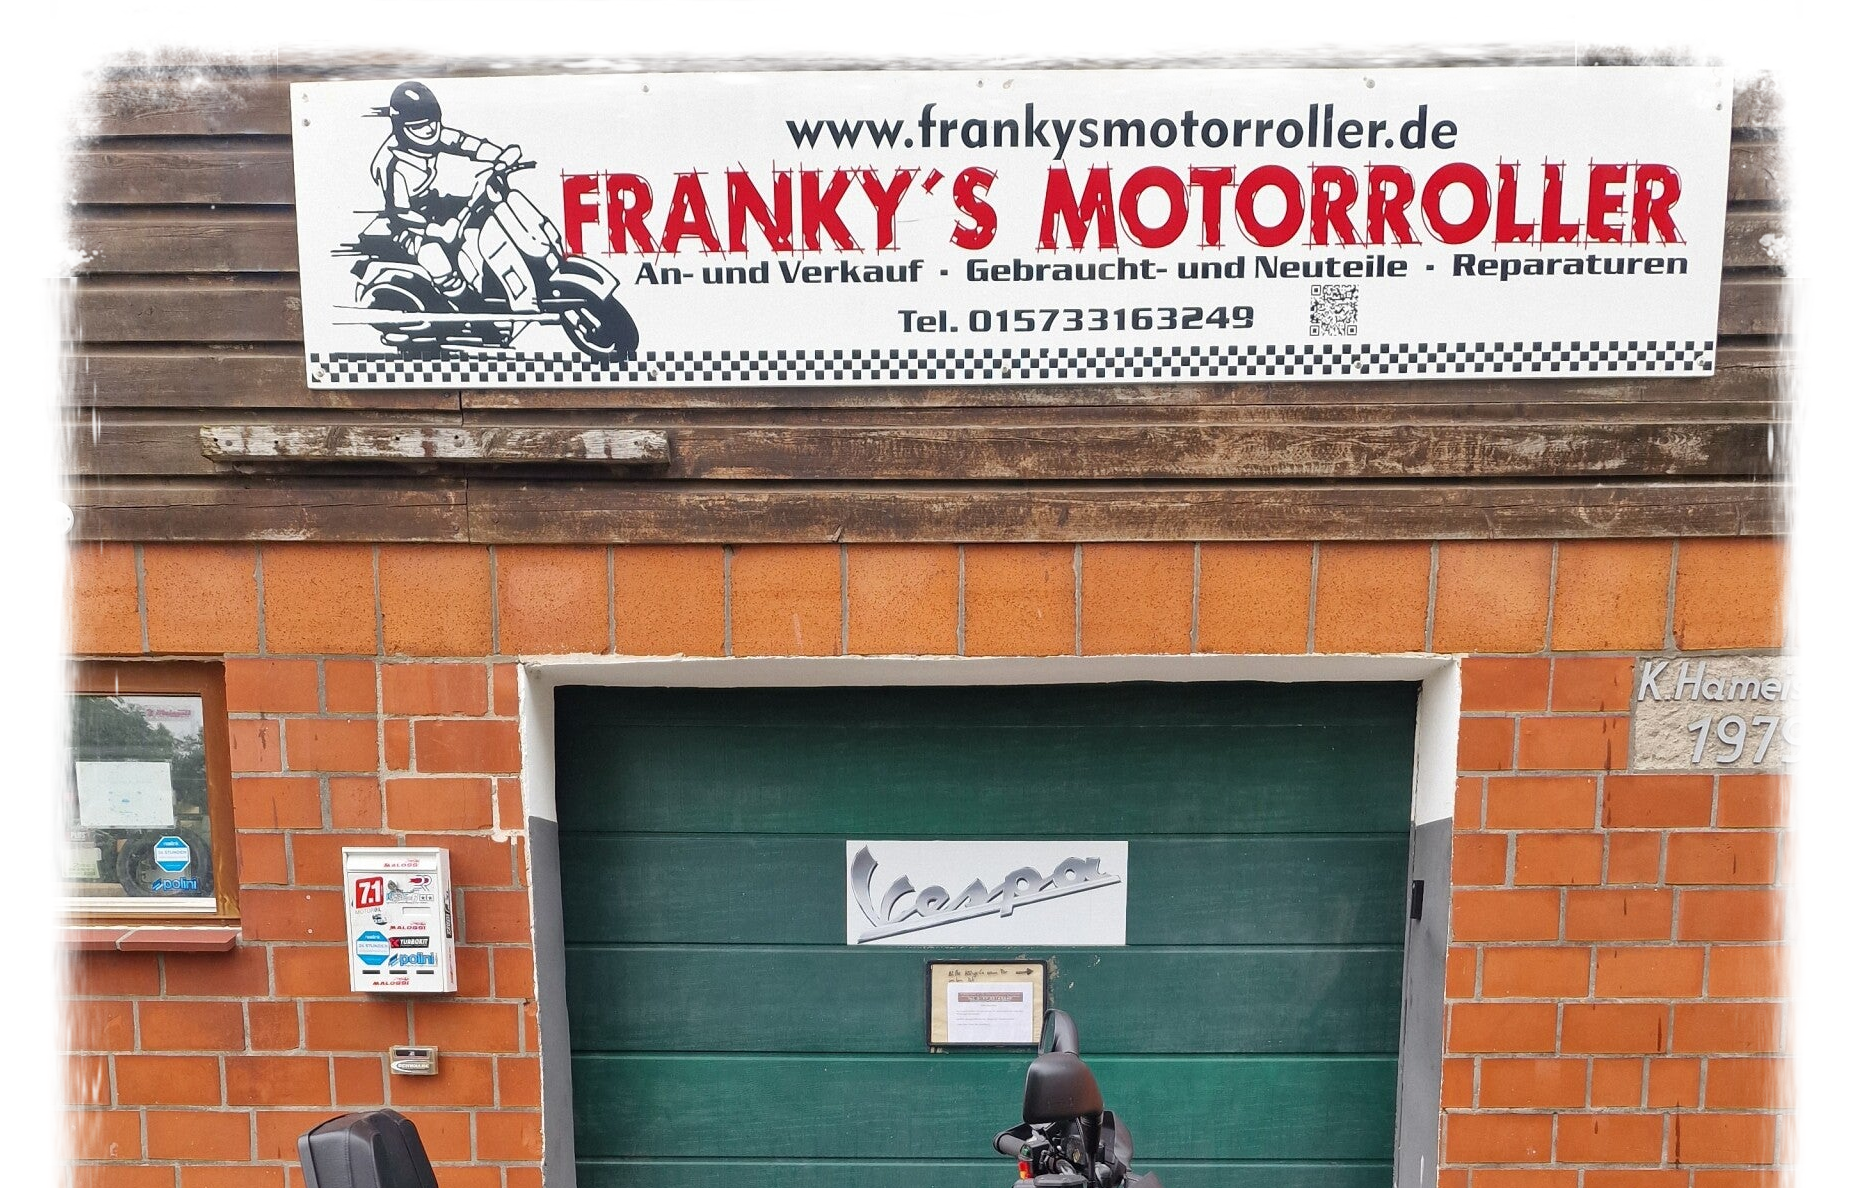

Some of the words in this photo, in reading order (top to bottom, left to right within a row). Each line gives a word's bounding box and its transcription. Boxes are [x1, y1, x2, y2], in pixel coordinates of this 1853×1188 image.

[786, 102, 1458, 159] www.frankysmotorroller.de
[1036, 161, 1684, 250] MOTORROLLER
[634, 261, 694, 285] An-
[702, 260, 770, 285] und
[779, 259, 925, 284] Verkauf
[966, 258, 1168, 282] Gebraucht-
[1177, 256, 1245, 280] und
[1255, 254, 1408, 279] Neuteile
[1453, 252, 1688, 280] Reparaturen
[898, 310, 959, 333] Tel.
[969, 306, 1254, 333] 015733163249
[163, 876, 198, 891] polini
[358, 880, 381, 905] 7.1
[851, 845, 1121, 943] Vespa
[399, 952, 435, 967] polini
